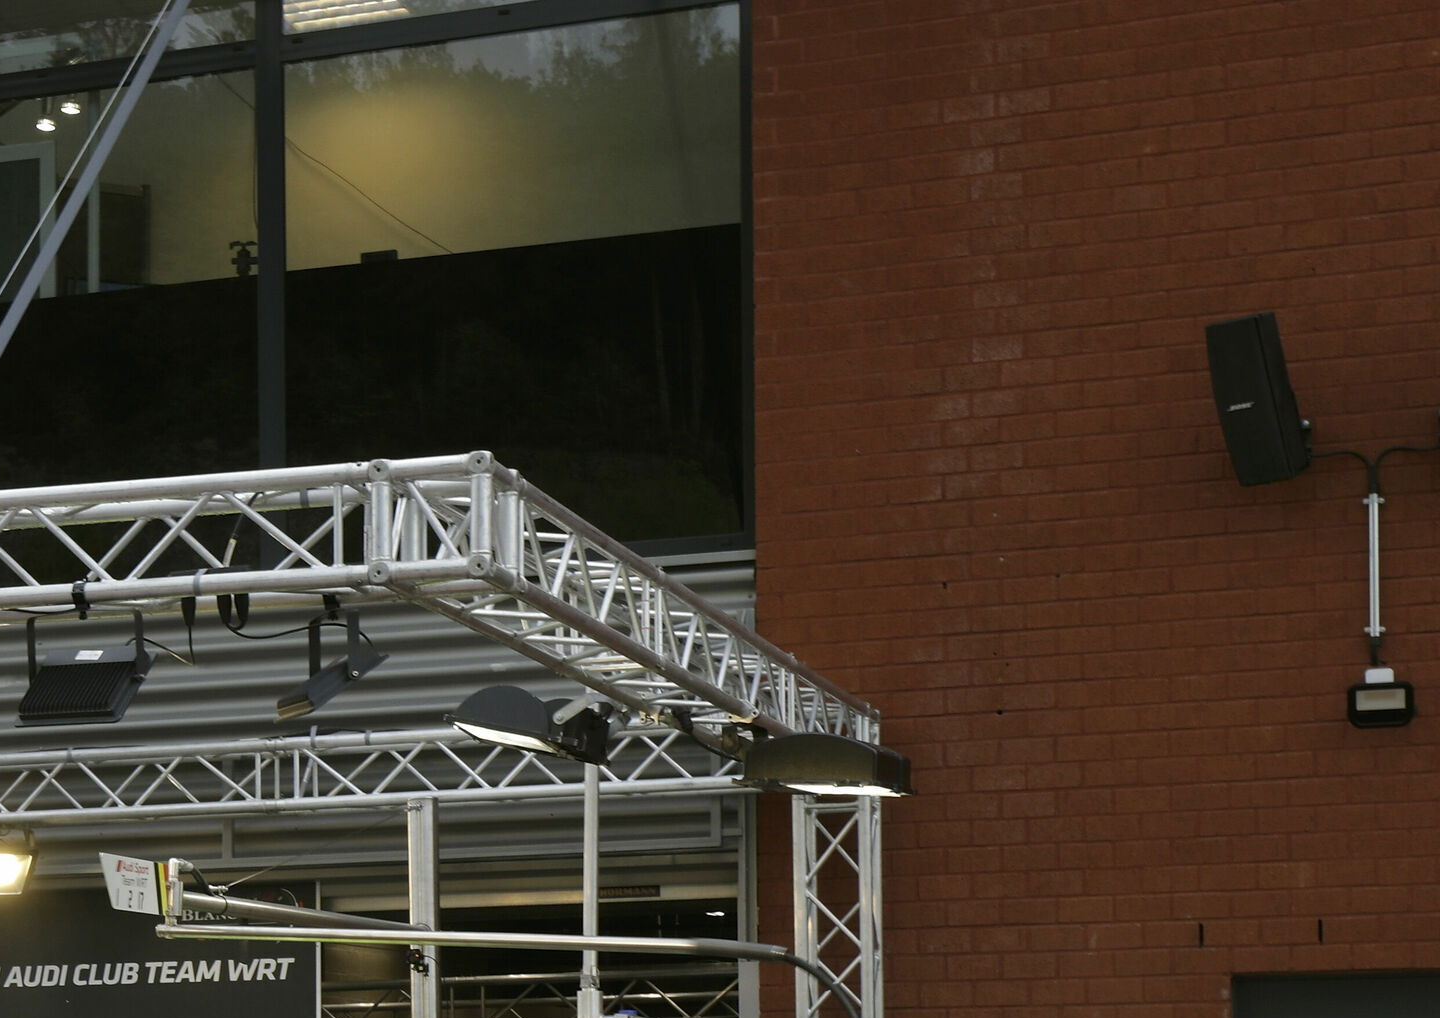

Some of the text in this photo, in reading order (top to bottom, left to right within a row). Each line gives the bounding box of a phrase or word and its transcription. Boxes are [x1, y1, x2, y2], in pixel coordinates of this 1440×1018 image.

[3, 963, 69, 988] AUDI
[72, 961, 139, 987] CLUB
[144, 959, 221, 984] TEAM
[227, 957, 295, 982] WRT
